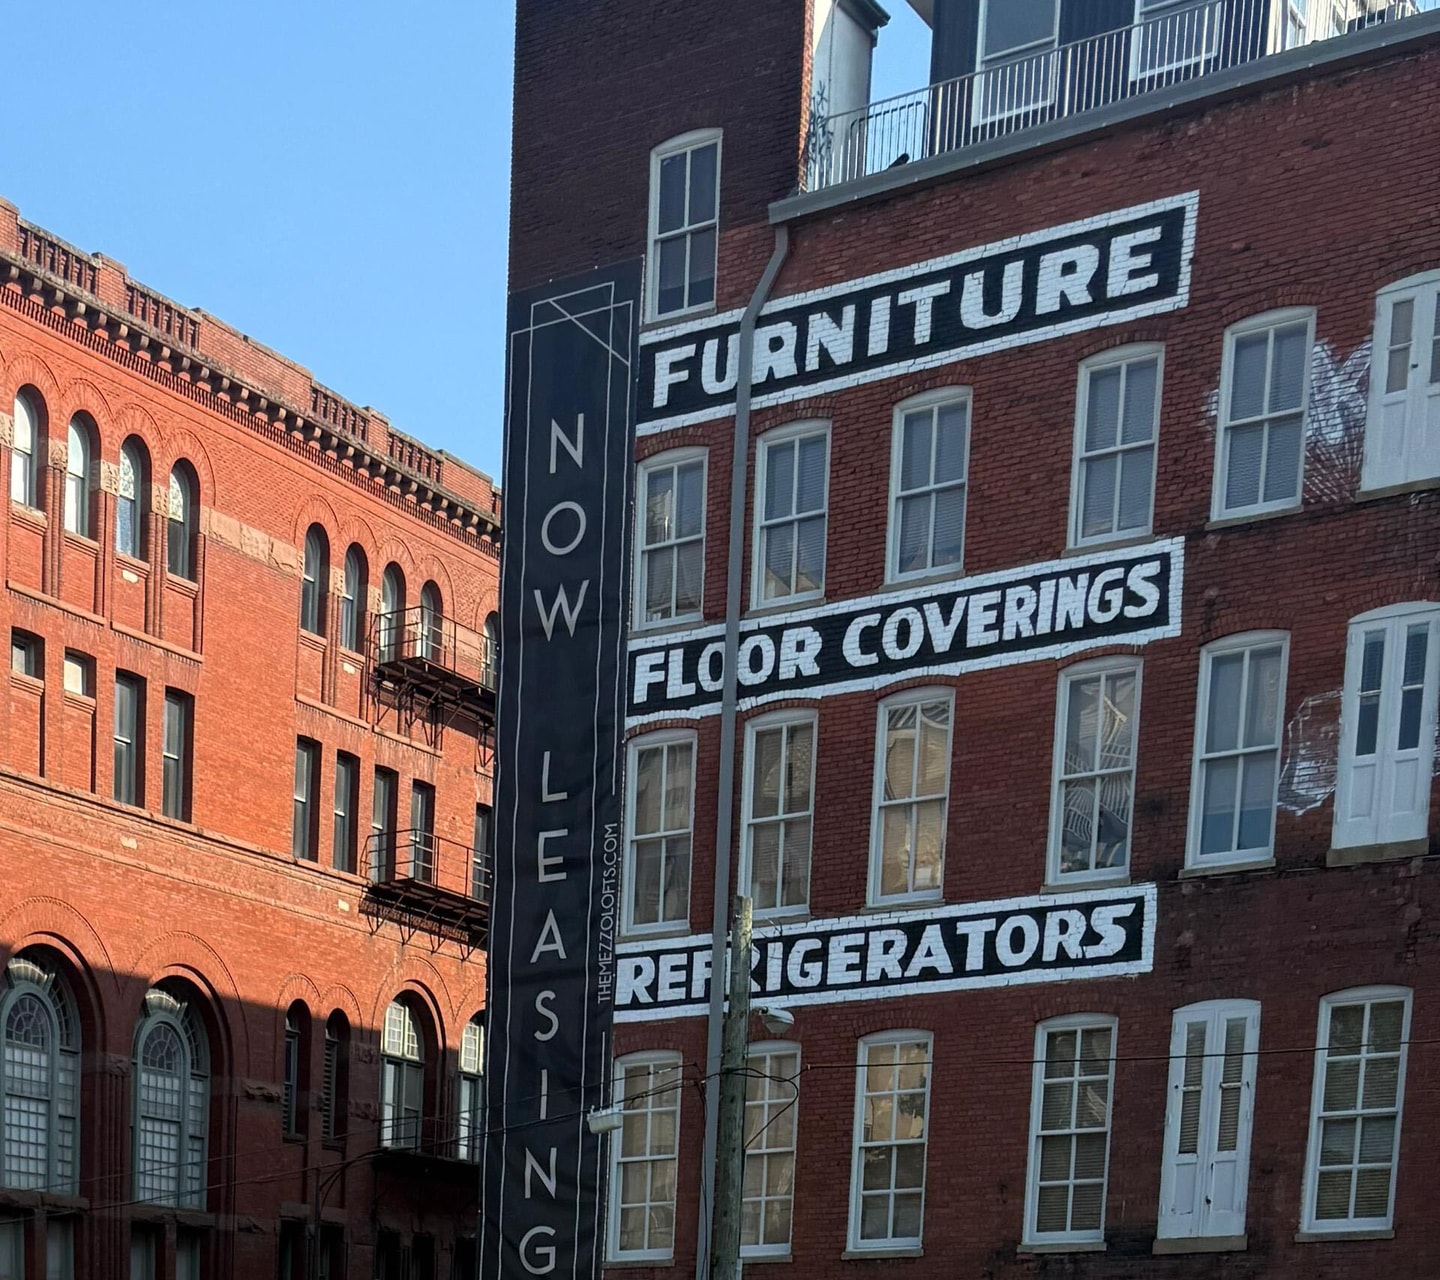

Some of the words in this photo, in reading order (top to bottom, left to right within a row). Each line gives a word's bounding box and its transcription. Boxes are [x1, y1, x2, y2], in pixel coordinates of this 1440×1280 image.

[651, 225, 1162, 408] FURNITURE
[534, 412, 590, 642] NOW
[632, 626, 822, 706] FLOOR
[842, 563, 1162, 669] COVERINGS
[597, 822, 618, 1005] THEMEZZOLOFTS.COM
[615, 901, 1136, 1006] REFRIGERATORS
[519, 750, 569, 1276] LEASING
